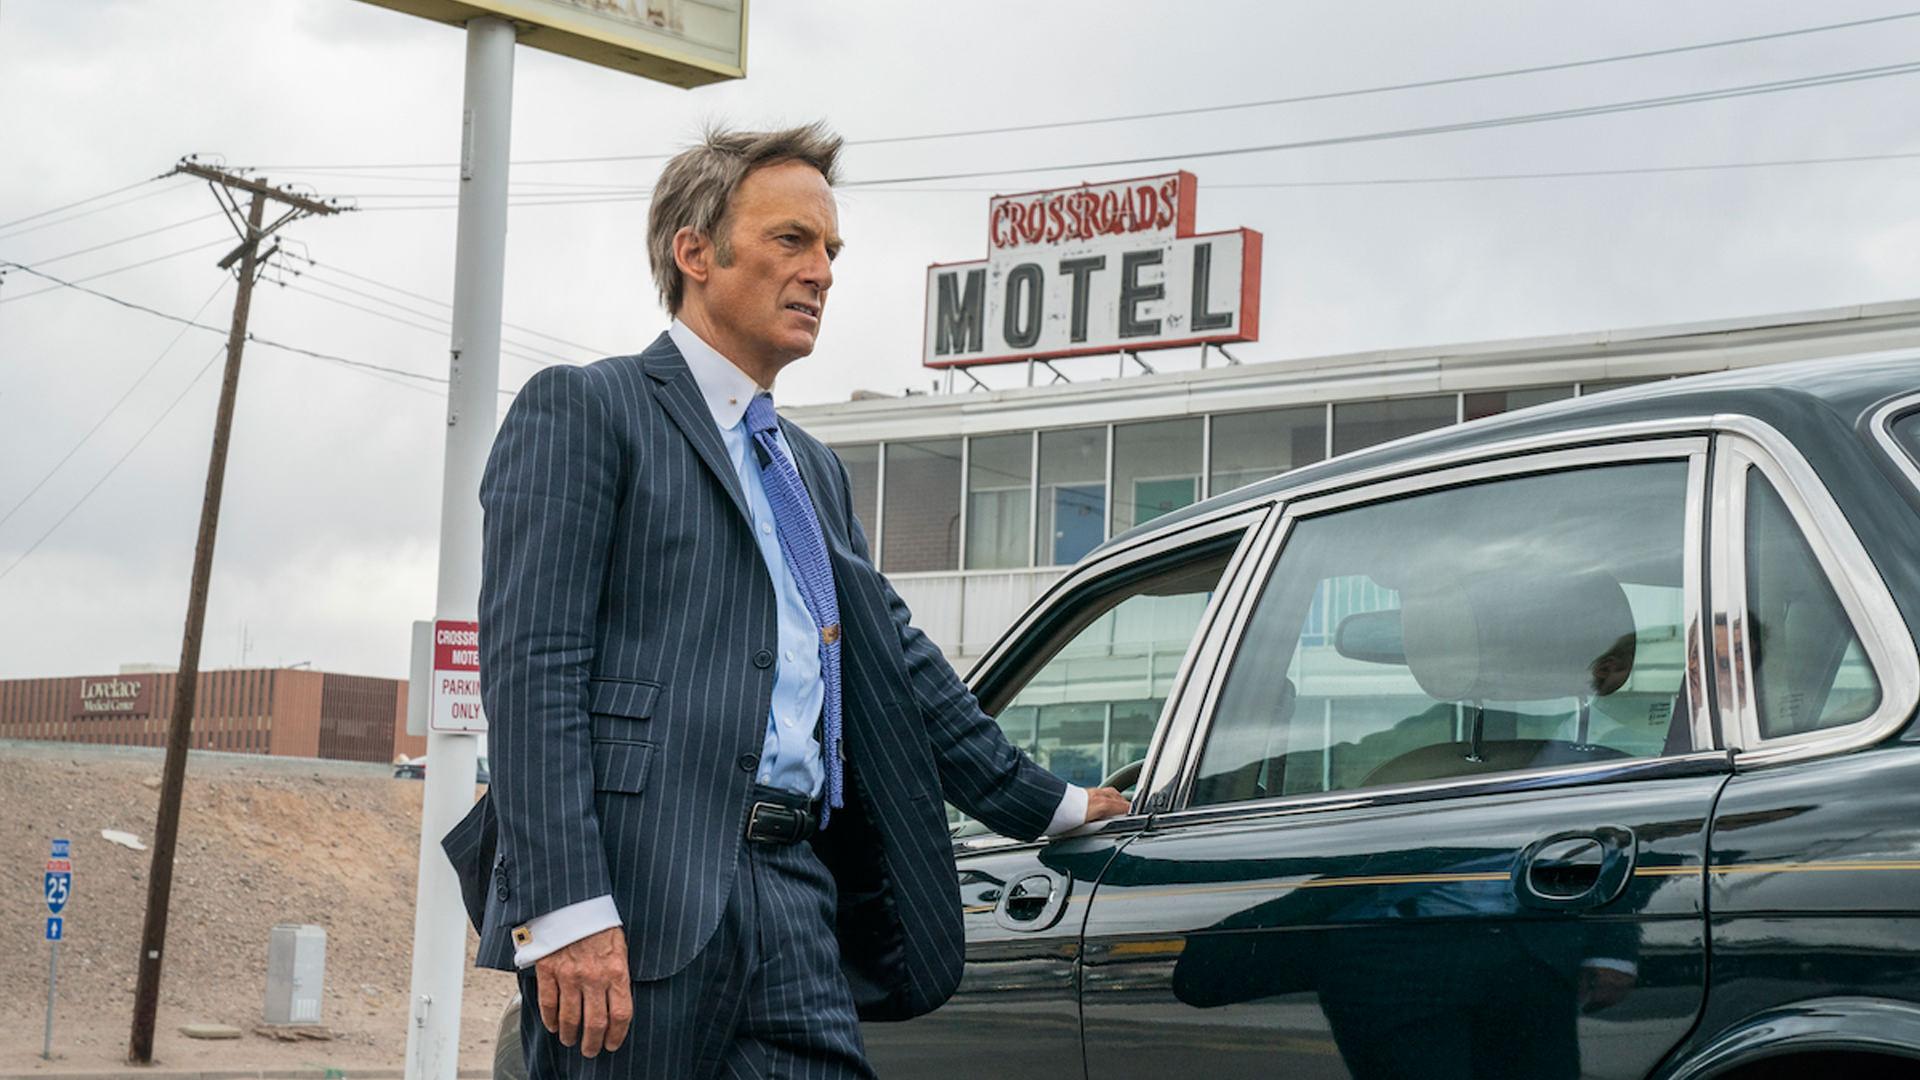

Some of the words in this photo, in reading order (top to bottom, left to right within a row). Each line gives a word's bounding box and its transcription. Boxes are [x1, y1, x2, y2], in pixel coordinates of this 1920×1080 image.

[991, 178, 1178, 249] CROSSROADS
[935, 243, 1233, 356] MOTEL
[81, 678, 140, 699] Lovelace
[85, 700, 111, 713] Medical
[112, 700, 134, 711] Center
[453, 703, 480, 719] ONLY
[48, 877, 67, 904] 25
